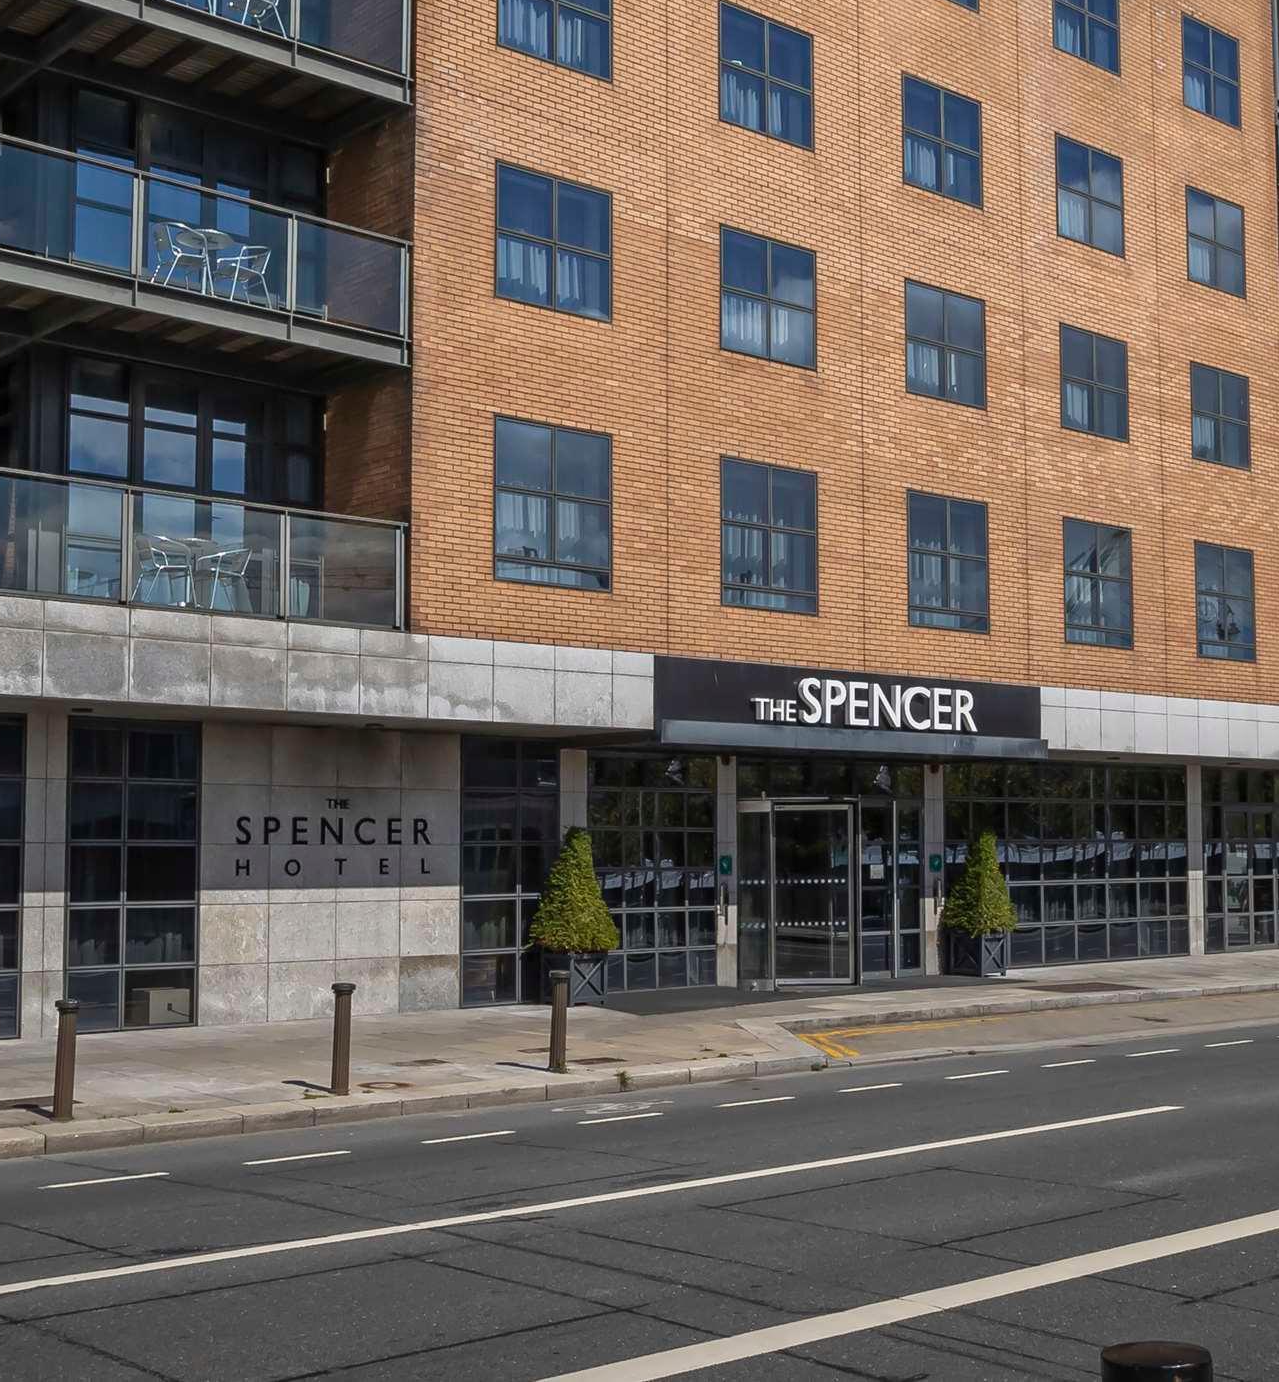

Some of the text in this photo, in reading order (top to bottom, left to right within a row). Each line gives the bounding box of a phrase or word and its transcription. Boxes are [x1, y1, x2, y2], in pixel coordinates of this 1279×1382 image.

[749, 677, 978, 732] THE SPENCER
[325, 798, 351, 810] THE
[235, 816, 431, 845] SPENCER
[235, 858, 431, 877] HOTEL
